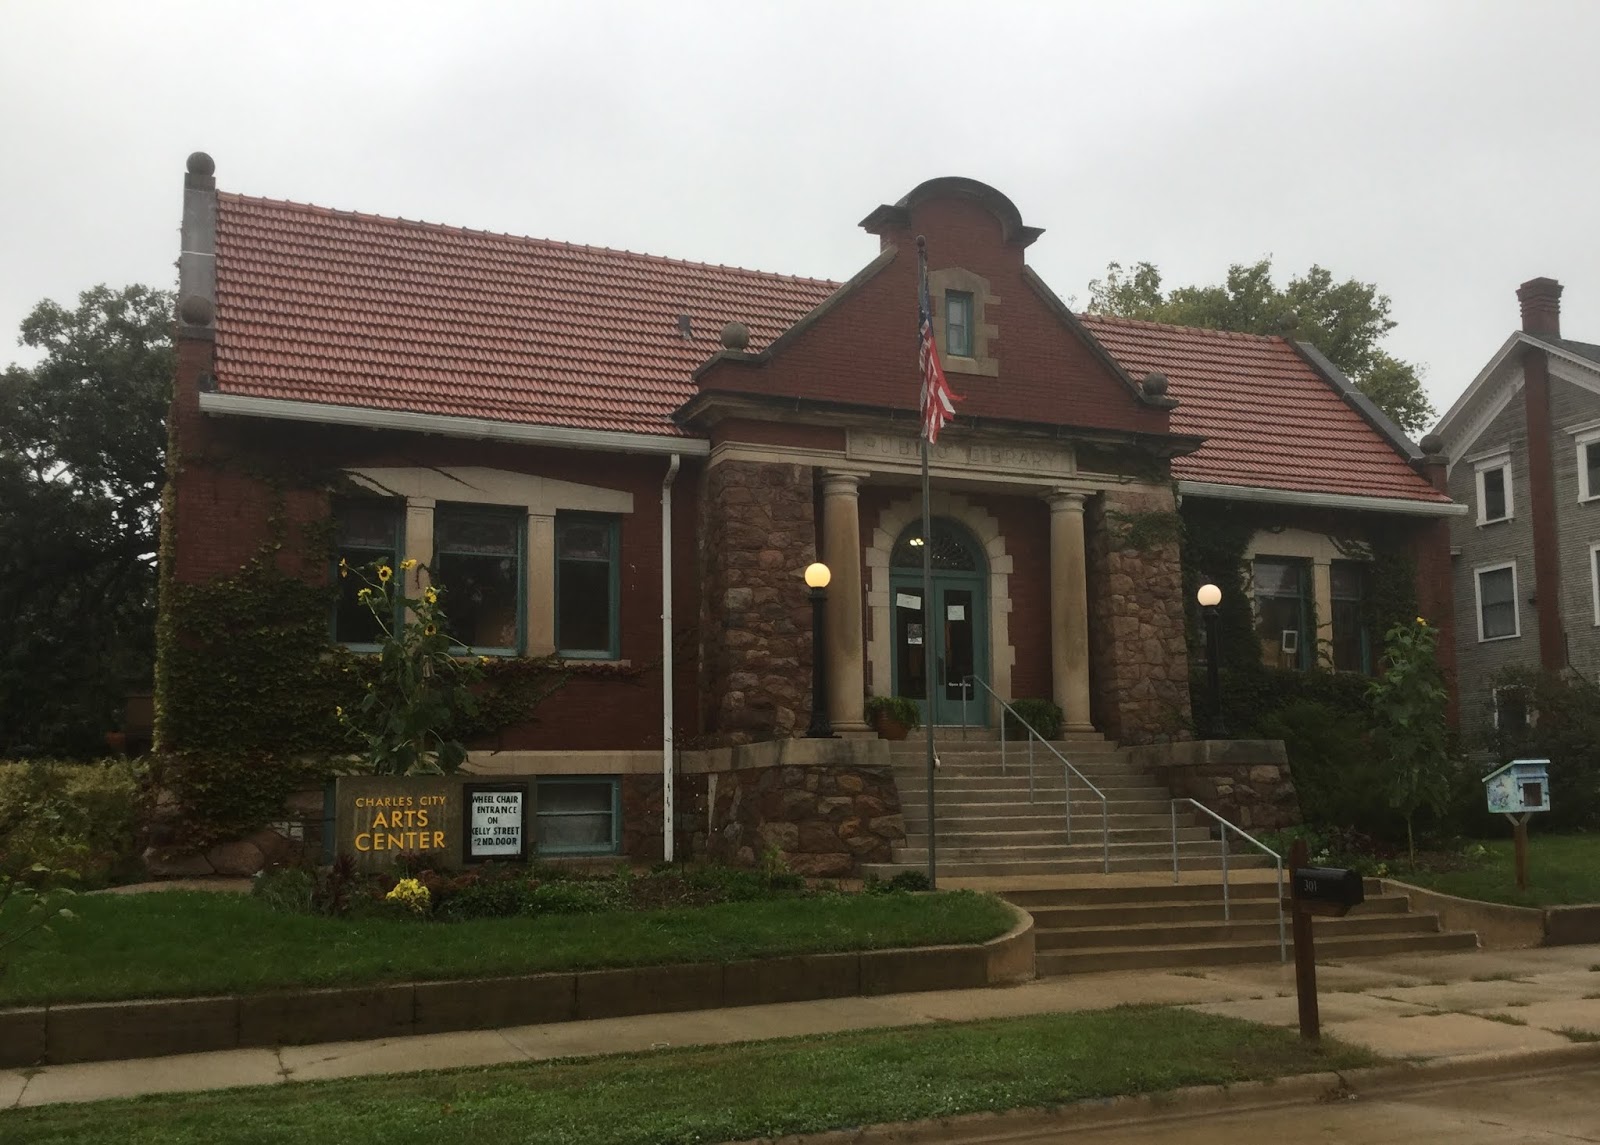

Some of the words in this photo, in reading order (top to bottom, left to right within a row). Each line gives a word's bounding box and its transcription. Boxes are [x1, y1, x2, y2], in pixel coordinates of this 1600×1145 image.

[969, 445, 1057, 469] LIBRARY
[355, 796, 413, 808] CHARLES
[419, 796, 447, 806] CITY
[472, 795, 494, 804] WHEEL
[496, 795, 519, 804] CHAIR
[477, 806, 517, 814] ENTRANCE
[372, 809, 429, 828] ARTS
[487, 816, 498, 825] ON
[493, 827, 520, 836] STREET
[355, 831, 446, 851] CENTER
[1304, 879, 1317, 892] 301
